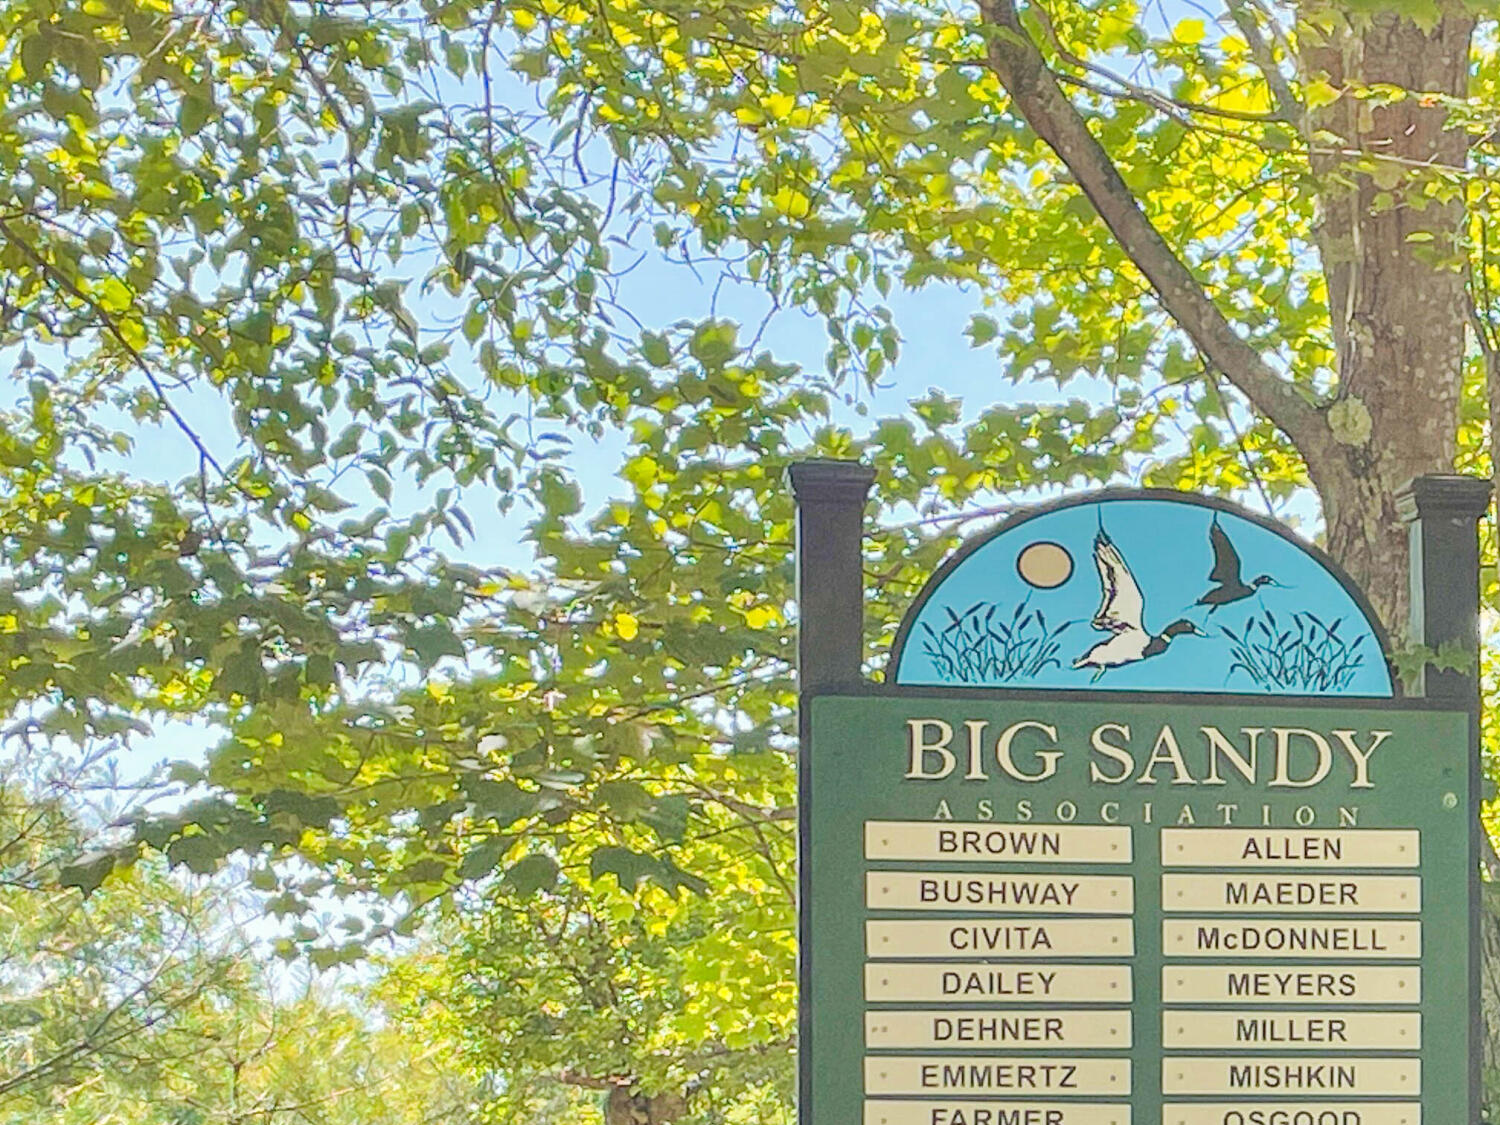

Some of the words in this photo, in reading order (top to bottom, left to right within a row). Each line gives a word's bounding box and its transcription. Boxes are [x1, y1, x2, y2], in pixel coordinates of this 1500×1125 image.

[904, 718, 1065, 782] BIG
[1089, 724, 1392, 789] SANDY
[933, 799, 1359, 827] ASSOCIATION
[939, 831, 1060, 856] BROWN
[1242, 837, 1342, 861] ALLEN
[920, 880, 1079, 906] BUSHWAY
[1226, 882, 1359, 906] MAEDER
[949, 926, 1052, 951] CIVITA
[1197, 927, 1386, 952] McDONNELL
[943, 972, 1056, 995] DAILEY
[1228, 974, 1357, 998] MEYERS
[934, 1018, 1064, 1042] DEHNER
[1236, 1020, 1346, 1042] MILLER
[921, 1065, 1077, 1089] EMMERTZ
[1229, 1065, 1356, 1089] MISHKIN
